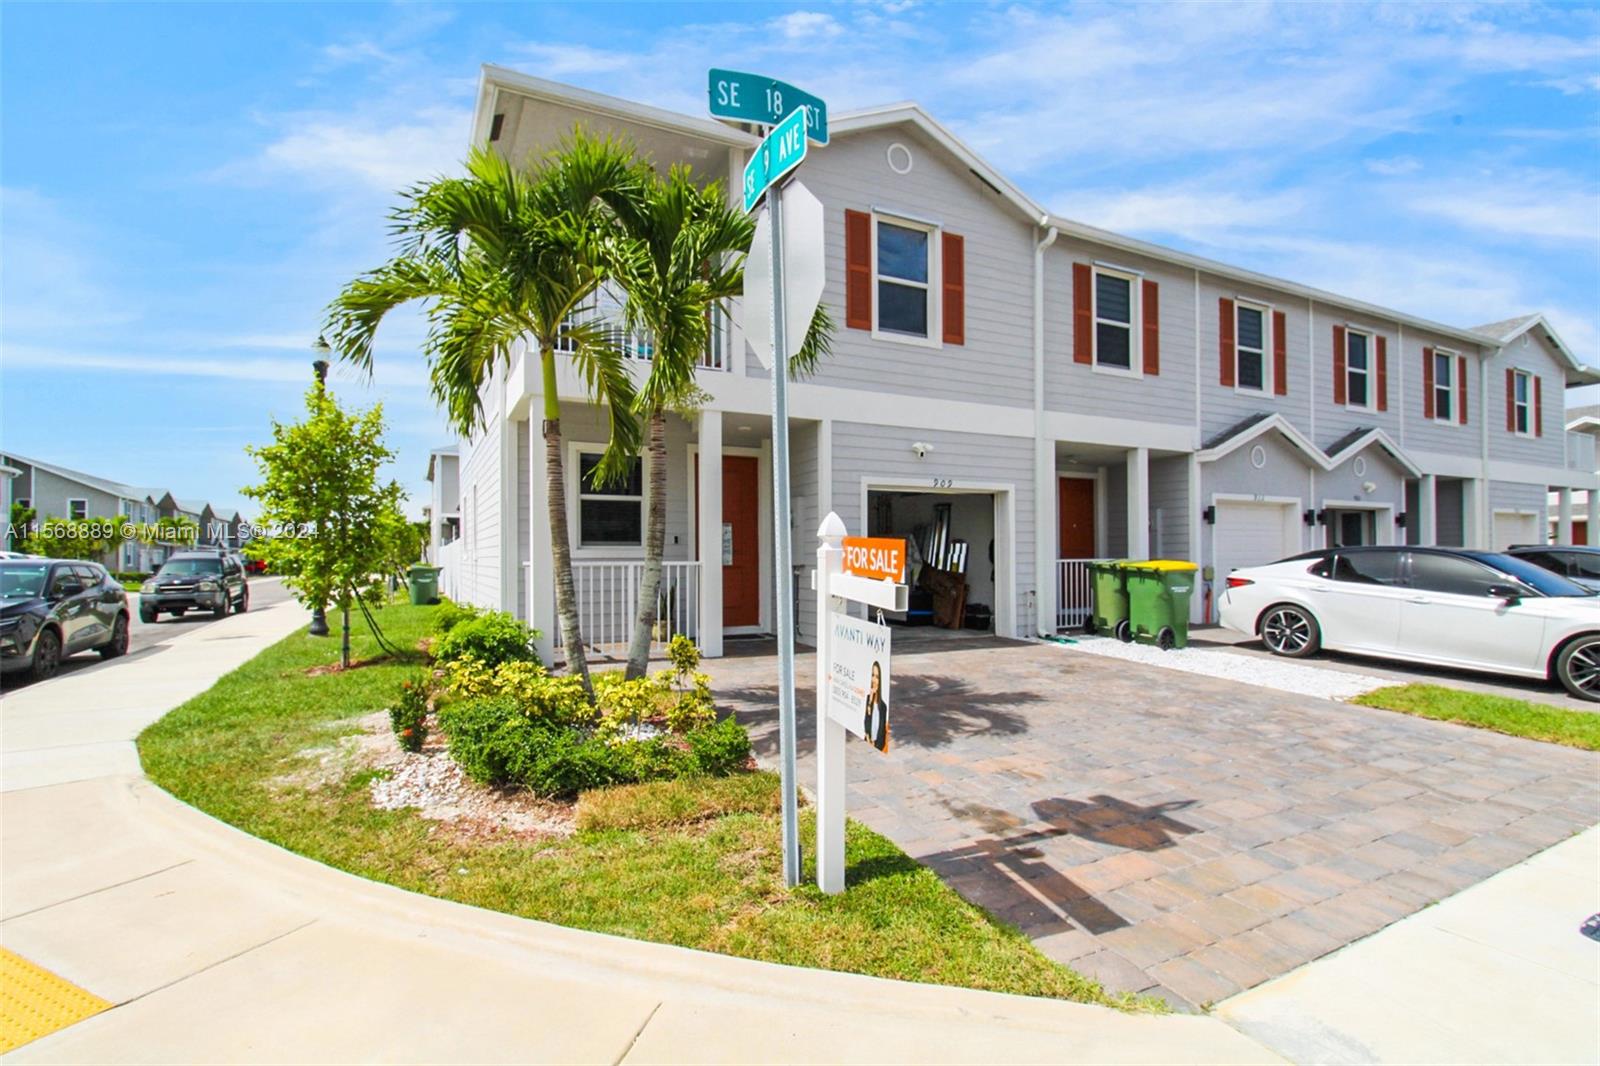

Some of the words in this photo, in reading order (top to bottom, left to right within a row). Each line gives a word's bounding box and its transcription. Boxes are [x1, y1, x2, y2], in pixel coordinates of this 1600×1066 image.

[718, 81, 740, 107] SE
[766, 89, 783, 115] 18
[805, 105, 820, 130] ST
[746, 169, 755, 199] SE
[763, 149, 770, 175] 9
[779, 123, 800, 162] AVE
[933, 478, 952, 488] 909
[847, 546, 869, 570] FOR
[869, 548, 899, 574] SALE
[835, 624, 864, 645] AVANTI
[866, 632, 886, 653] WAY
